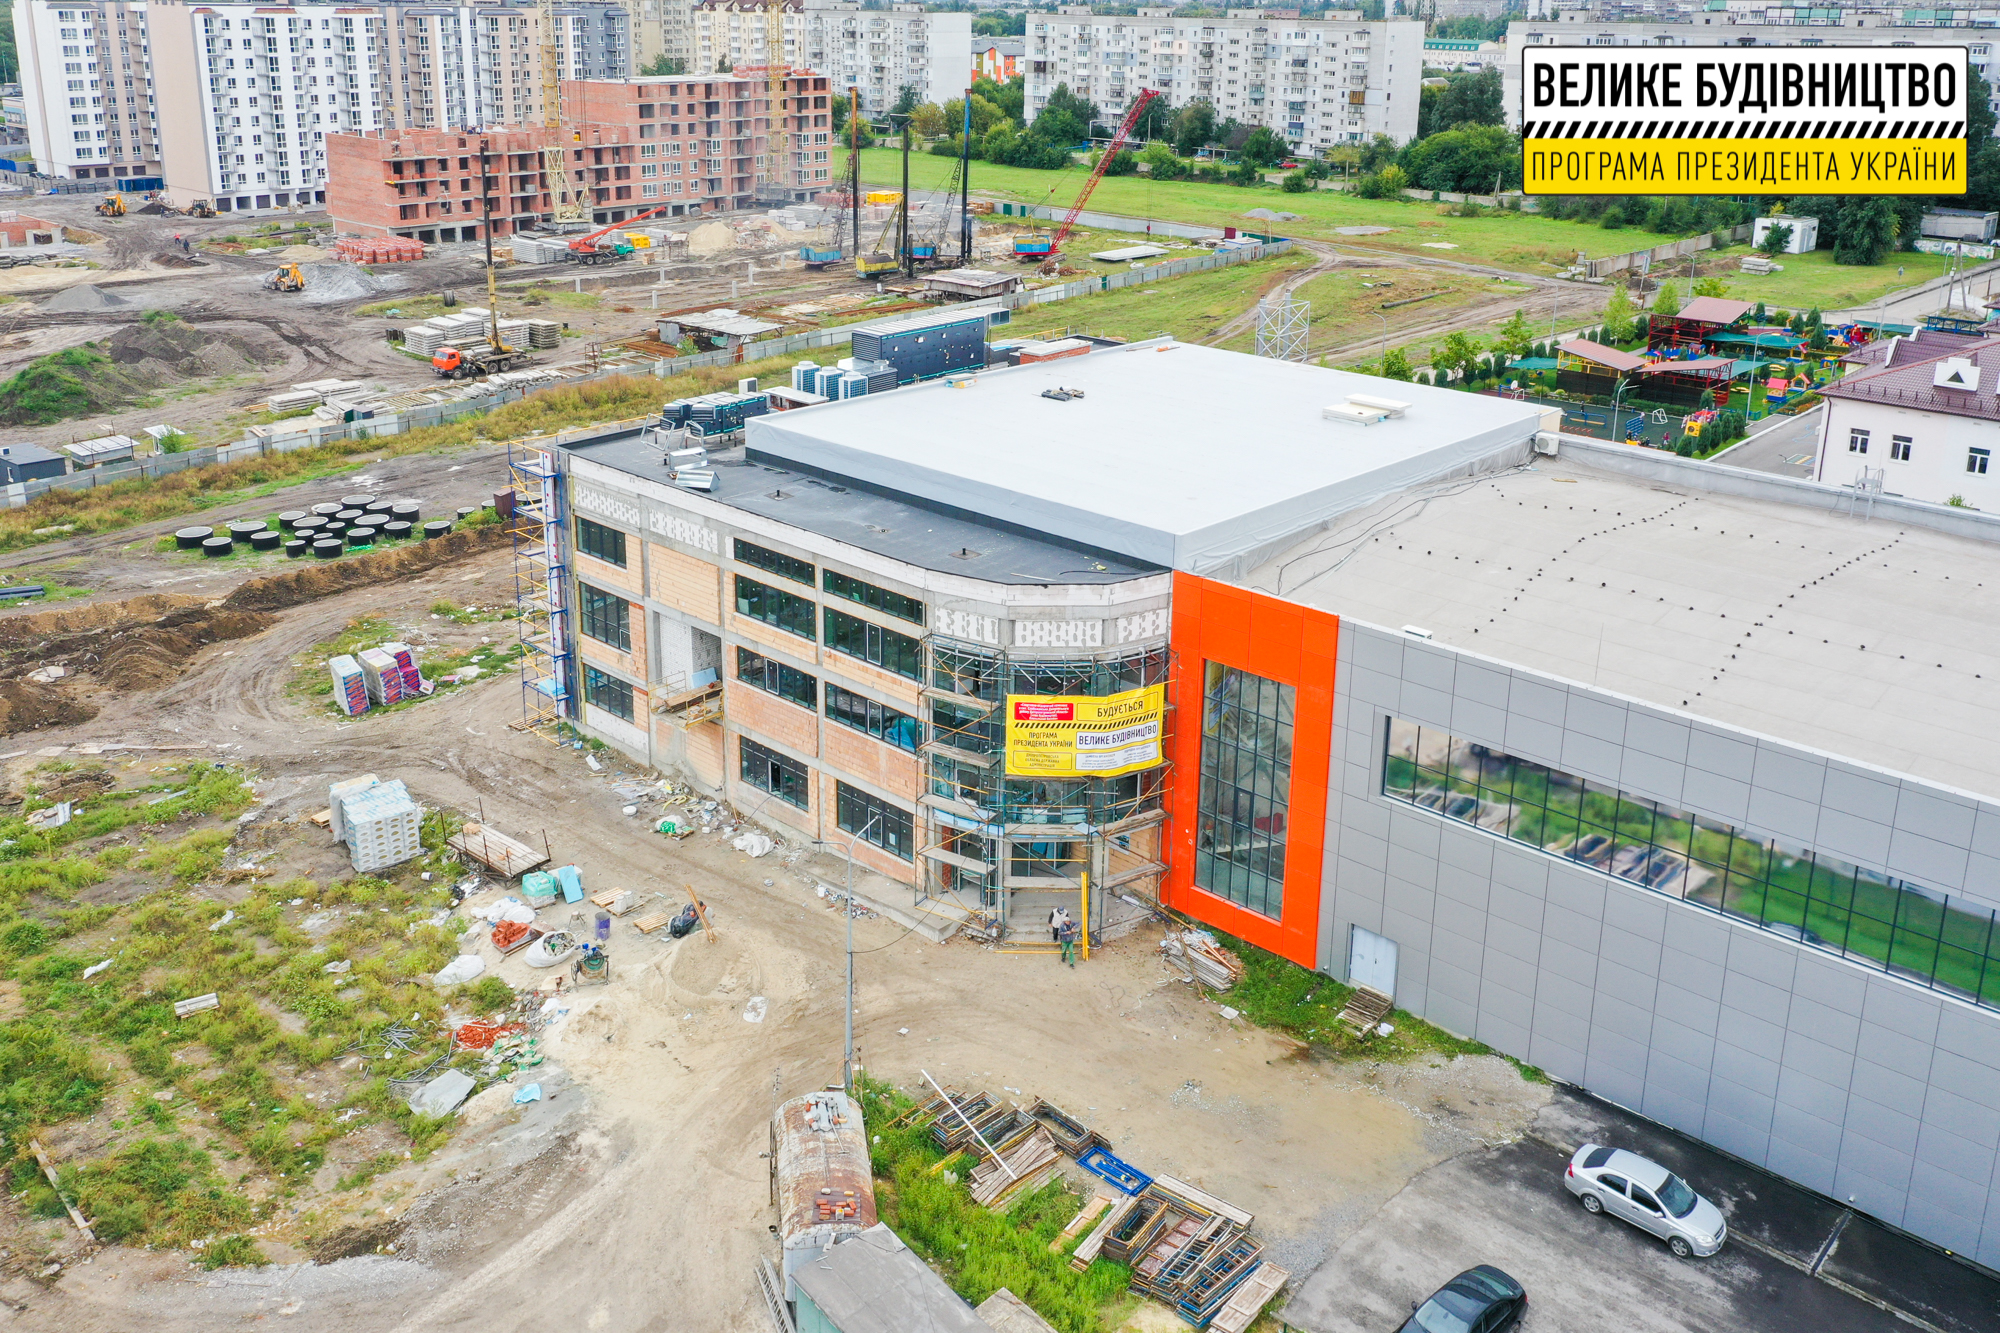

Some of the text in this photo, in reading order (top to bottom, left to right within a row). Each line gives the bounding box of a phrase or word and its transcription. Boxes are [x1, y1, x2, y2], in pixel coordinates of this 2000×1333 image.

[1097, 700, 1144, 718] БУДУЄТЬСЯ
[1029, 731, 1058, 739] ПРОГРАМА
[1078, 724, 1157, 745] ВЕЛИКЕ БУДІВНИЦТВО
[1013, 739, 1073, 748] ПРЕЗИДЕНТА УКРАЇНИ
